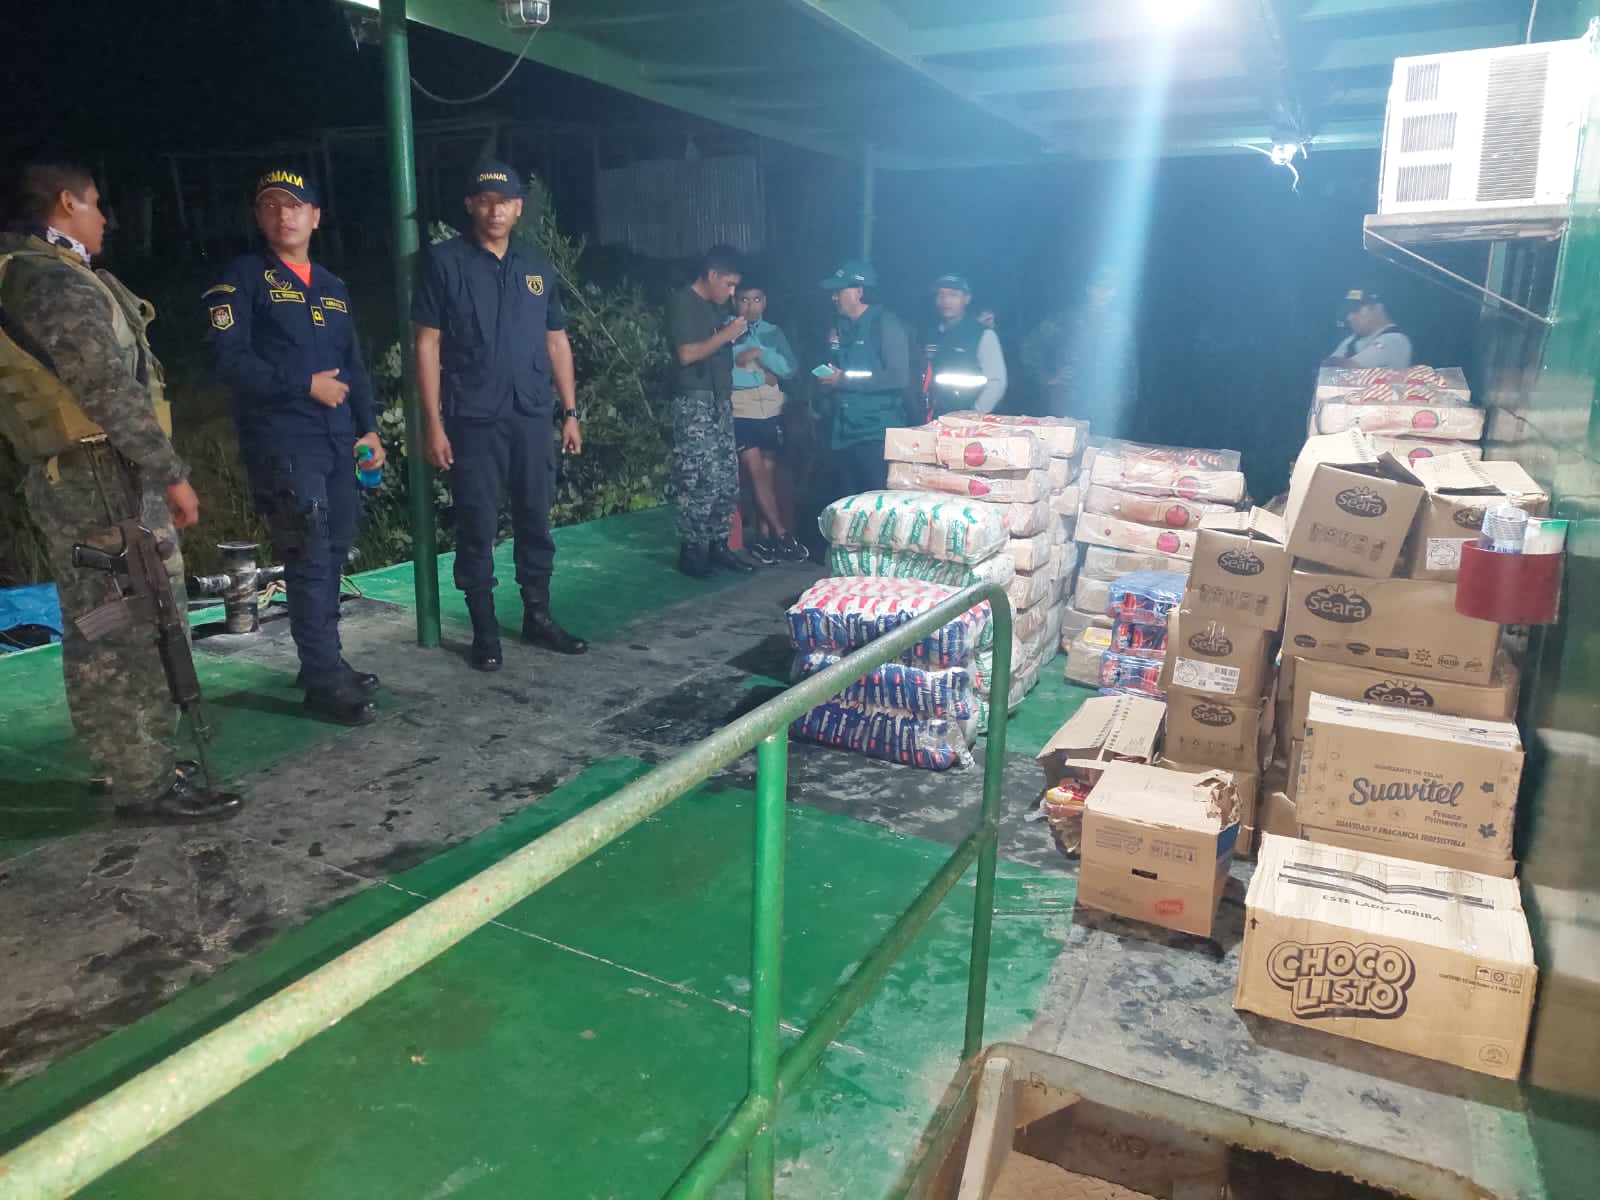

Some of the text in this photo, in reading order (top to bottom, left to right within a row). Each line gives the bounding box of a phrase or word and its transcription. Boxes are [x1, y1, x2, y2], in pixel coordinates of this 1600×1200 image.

[1338, 494, 1383, 514] Seara
[1220, 556, 1261, 573] Seara
[1308, 595, 1367, 618] Seara
[1193, 708, 1233, 724] Seara
[1349, 777, 1464, 807] Suavitel
[1322, 894, 1443, 922] ESTE LADO ARRIBA
[1271, 944, 1407, 984] CHOCO
[1296, 977, 1399, 1011] LISTO
